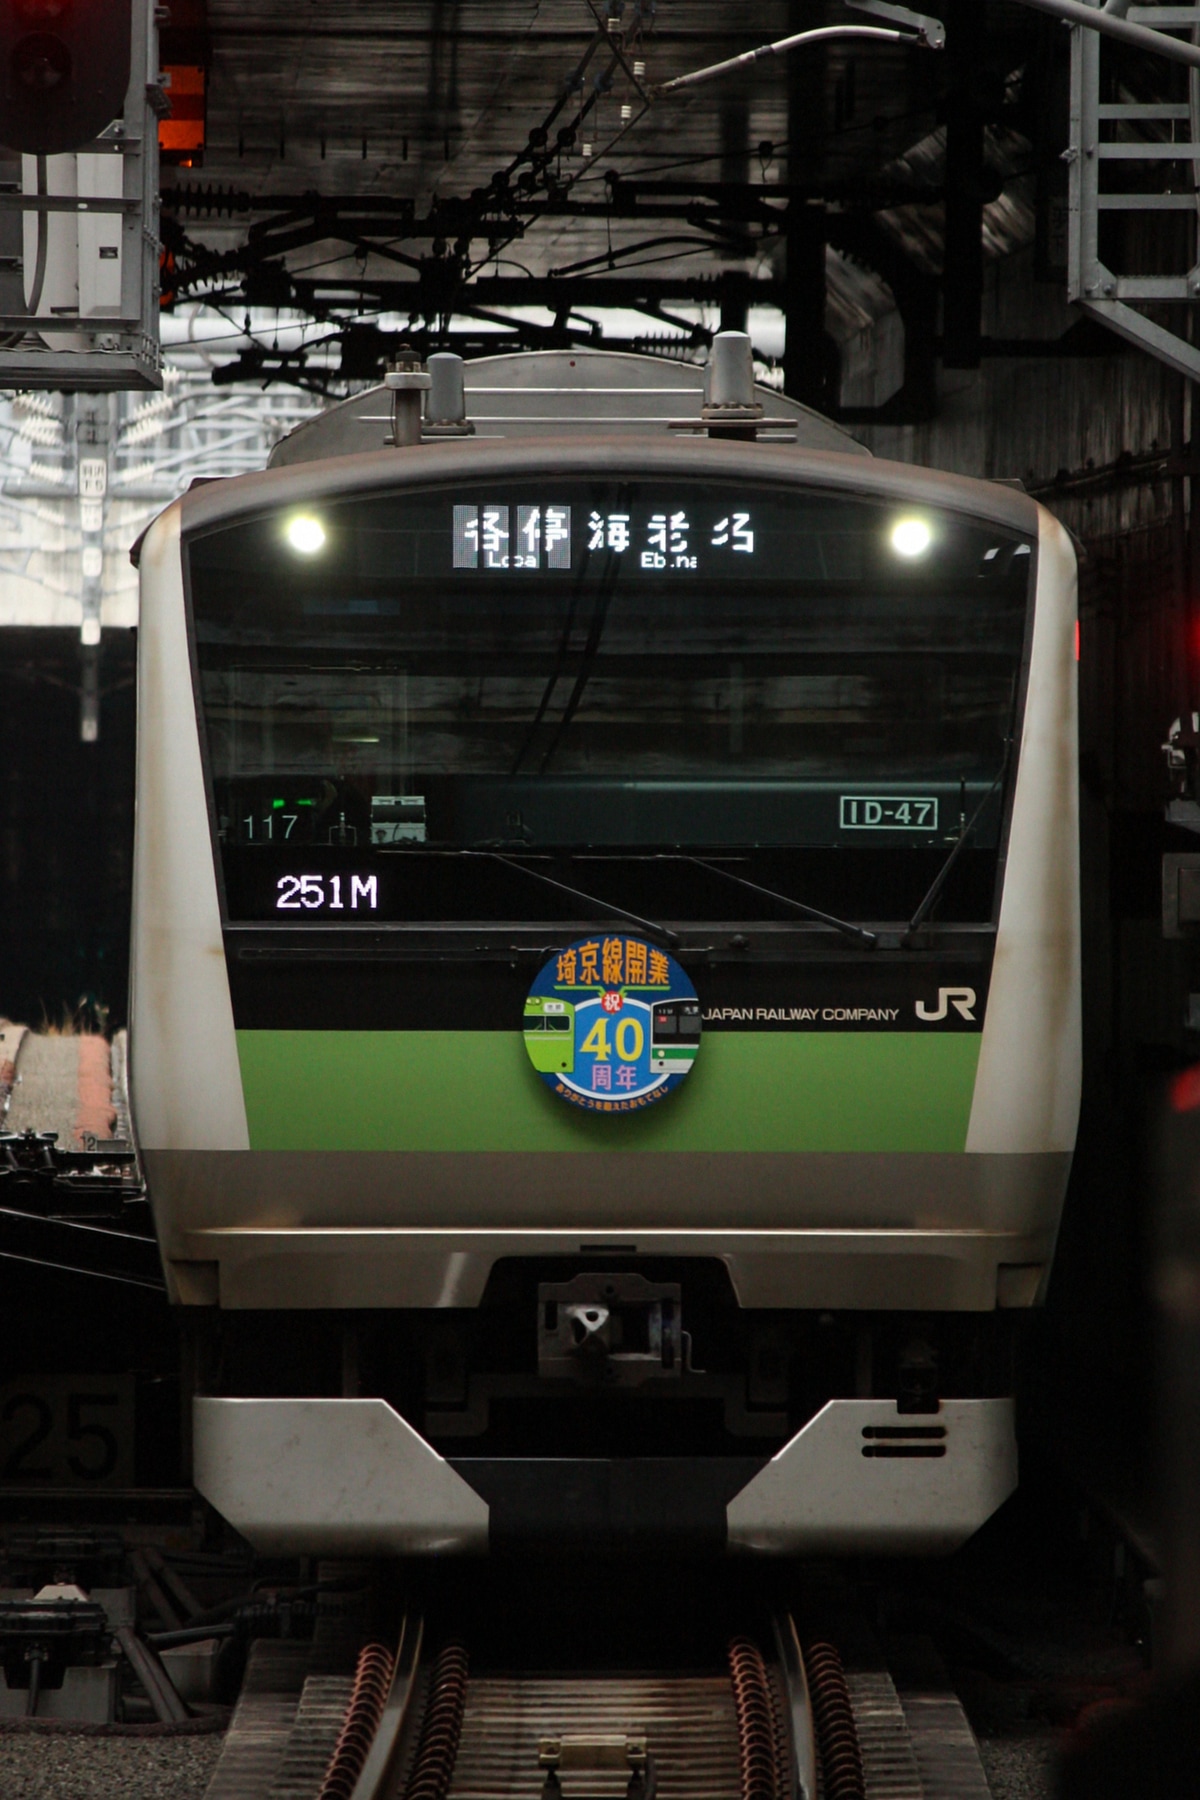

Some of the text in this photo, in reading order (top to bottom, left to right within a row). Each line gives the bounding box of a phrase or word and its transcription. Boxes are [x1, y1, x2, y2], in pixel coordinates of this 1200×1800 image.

[243, 814, 298, 839] 117
[850, 801, 931, 825] ID-47
[276, 874, 379, 909] 251M
[556, 937, 670, 985] 埼京線開業
[604, 993, 620, 1012] 祝
[702, 1007, 754, 1021] JAPAN
[756, 1007, 820, 1021] RAILWAY
[822, 1007, 900, 1021] COMPANY
[914, 986, 977, 1022] JR
[579, 1017, 645, 1062] 40
[591, 1065, 637, 1091] 周年
[2, 1393, 119, 1480] 25
